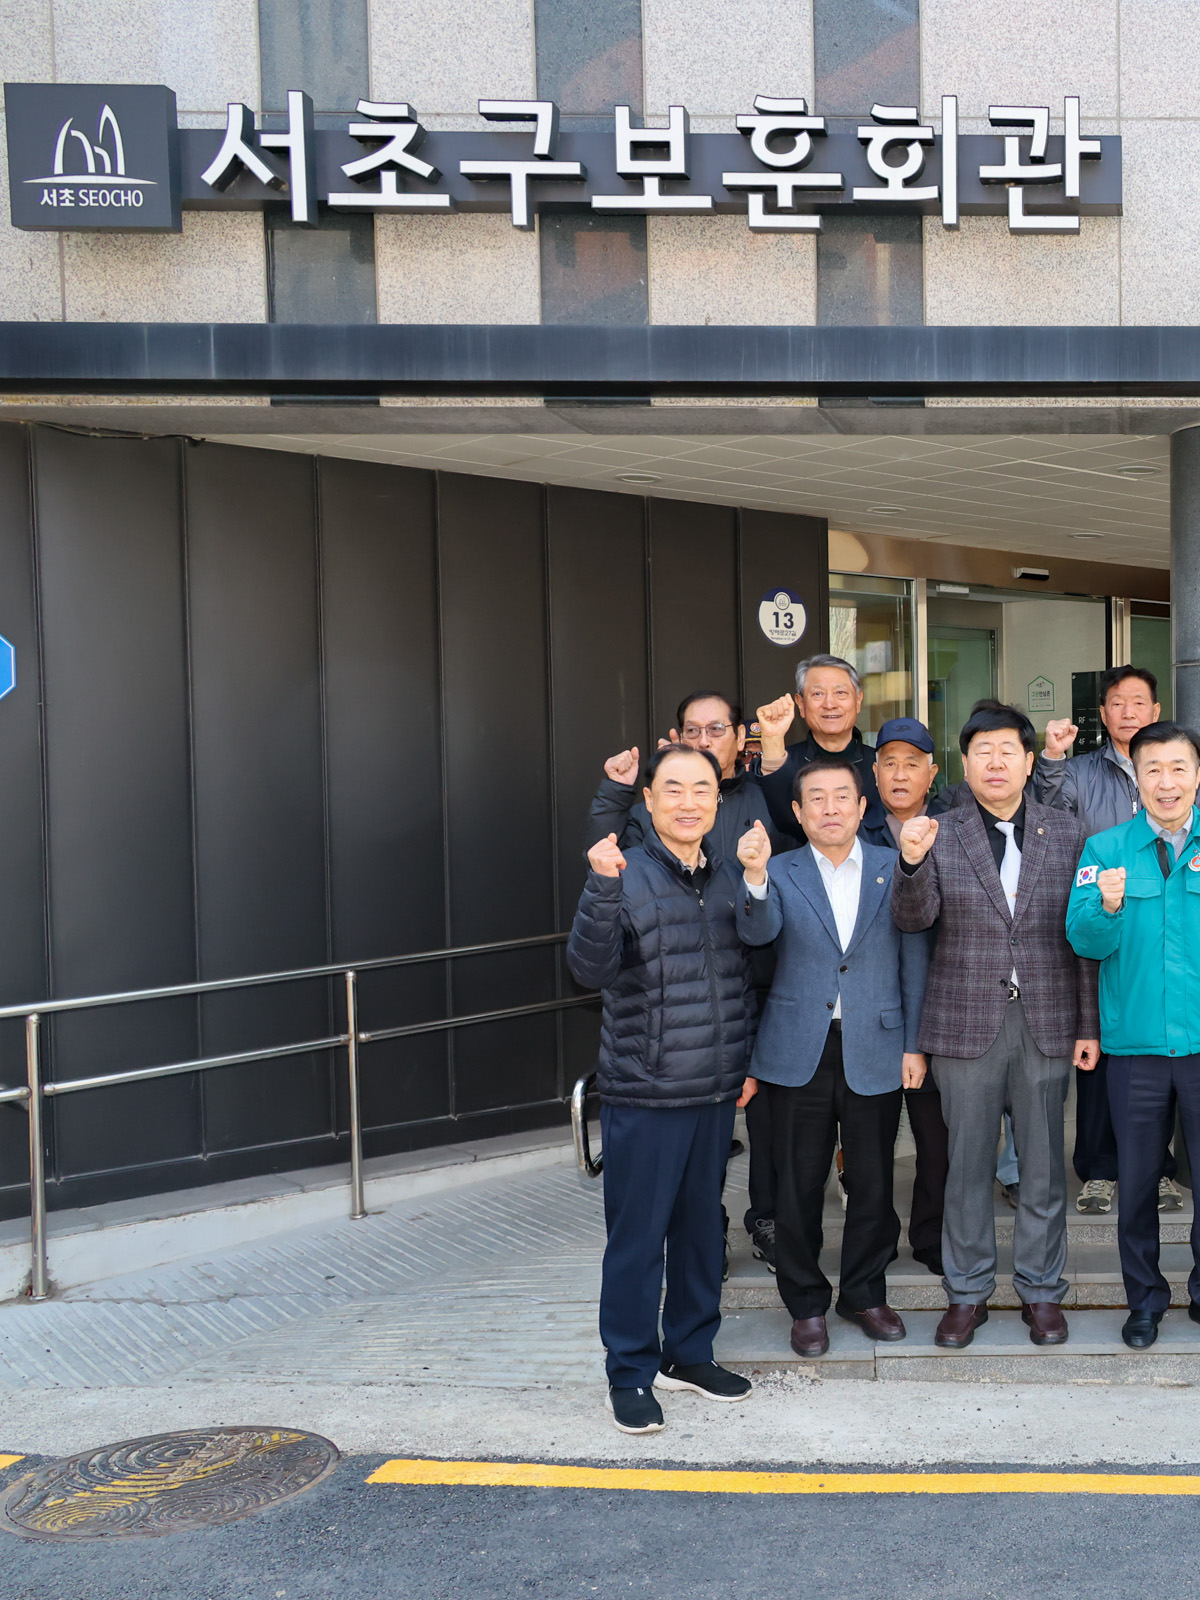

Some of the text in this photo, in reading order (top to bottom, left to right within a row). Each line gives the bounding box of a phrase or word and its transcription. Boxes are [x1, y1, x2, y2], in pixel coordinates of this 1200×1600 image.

[200, 90, 1102, 232] 서초구보훈회관
[40, 188, 143, 208] 서초 SEOCHO
[772, 611, 794, 629] 13
